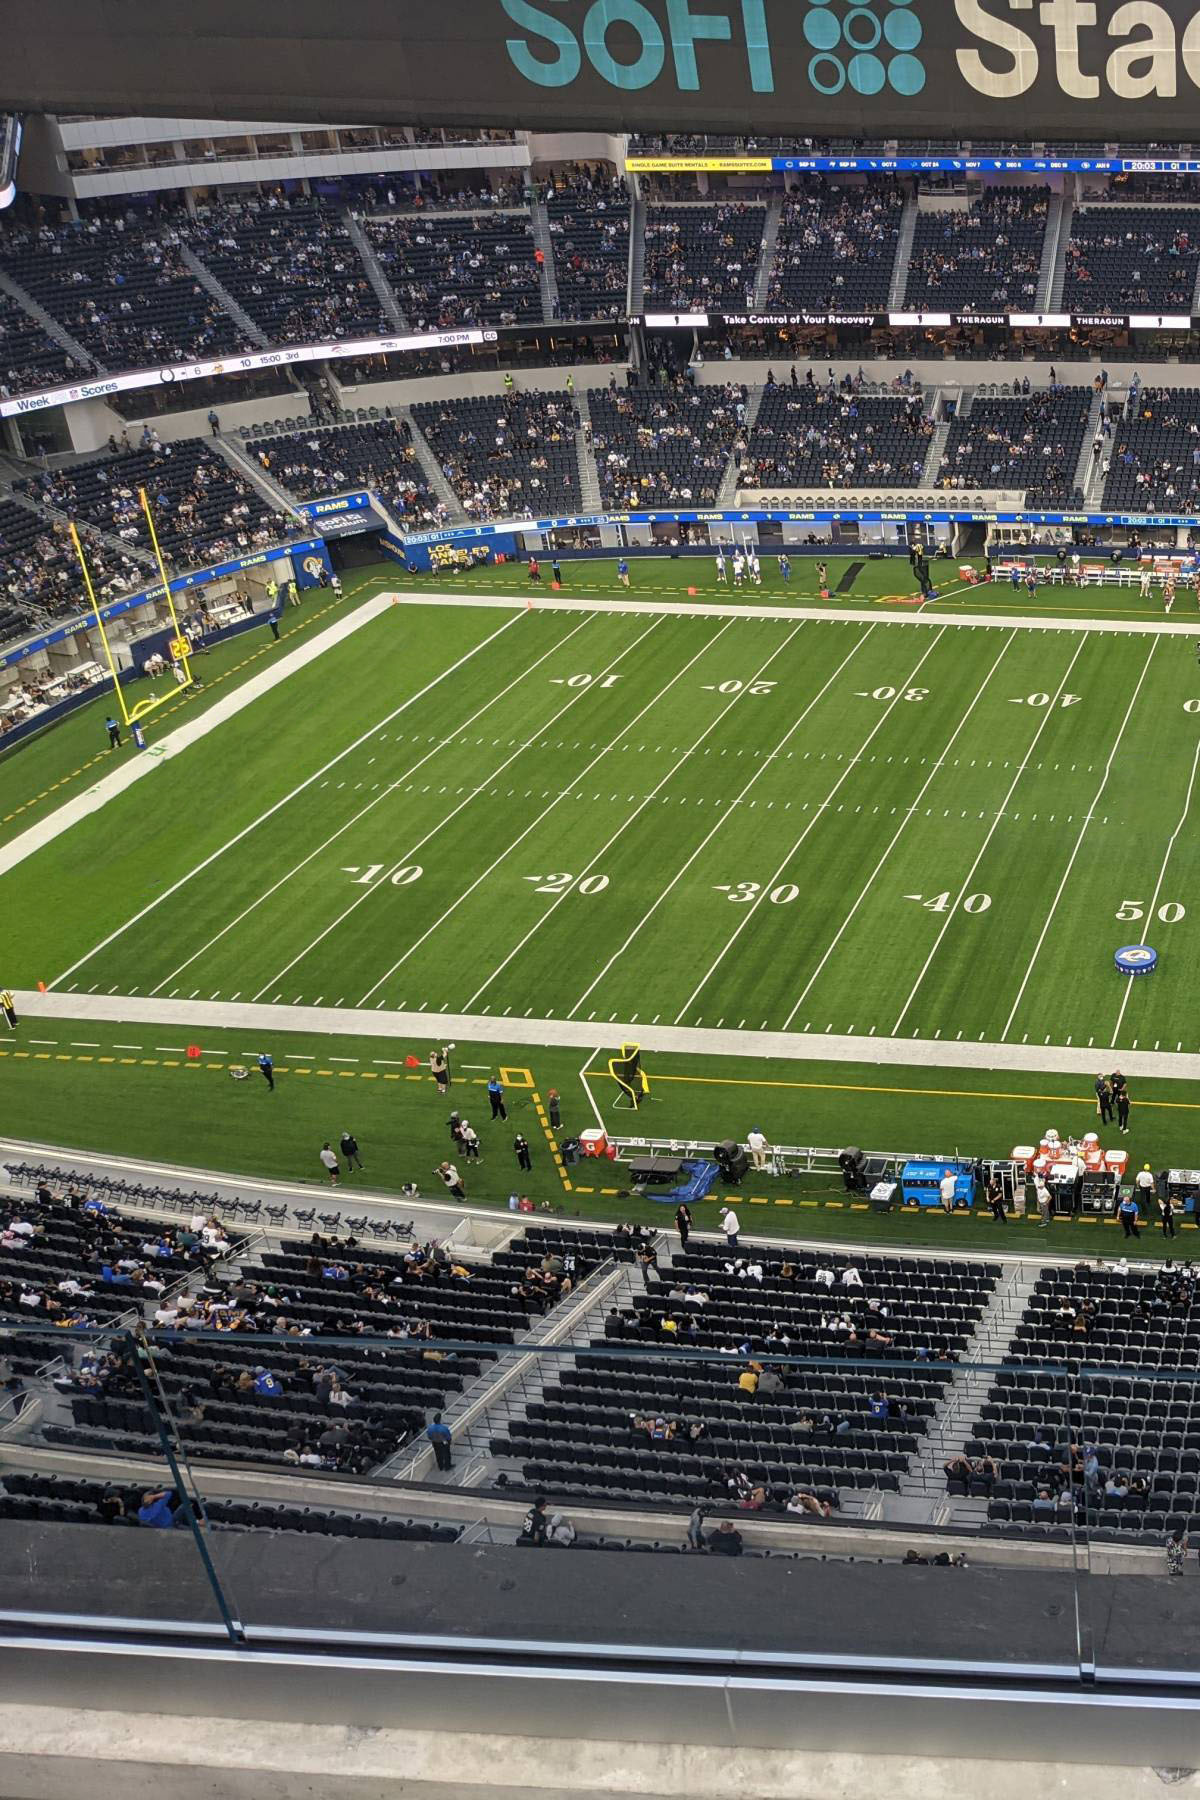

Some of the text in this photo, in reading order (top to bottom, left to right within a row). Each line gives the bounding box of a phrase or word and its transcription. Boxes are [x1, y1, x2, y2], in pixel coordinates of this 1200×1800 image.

[1131, 162, 1180, 170] 20:03 Q1
[723, 315, 875, 326] Take Control of Your Recovery
[957, 316, 1005, 324] THERAGUN
[1076, 317, 1124, 325] THERAGUN
[439, 334, 470, 344] 7:00 PM
[259, 351, 299, 364] 15:00 3rd
[195, 359, 252, 375] 6 10
[17, 382, 118, 411] Week Scores
[316, 500, 350, 513] RAMS
[320, 518, 368, 531] Stadium
[607, 514, 631, 522] AMS
[428, 543, 453, 554] LOS
[240, 555, 267, 568] RAMS
[64, 620, 88, 635] RAMS
[350, 864, 425, 885] 10
[534, 872, 611, 894] 20
[727, 881, 800, 904] 30
[922, 891, 992, 914] 40
[1115, 900, 1186, 924] 50
[585, 1142, 596, 1151] G
[563, 1260, 576, 1271] 34
[266, 1378, 274, 1389] 9
